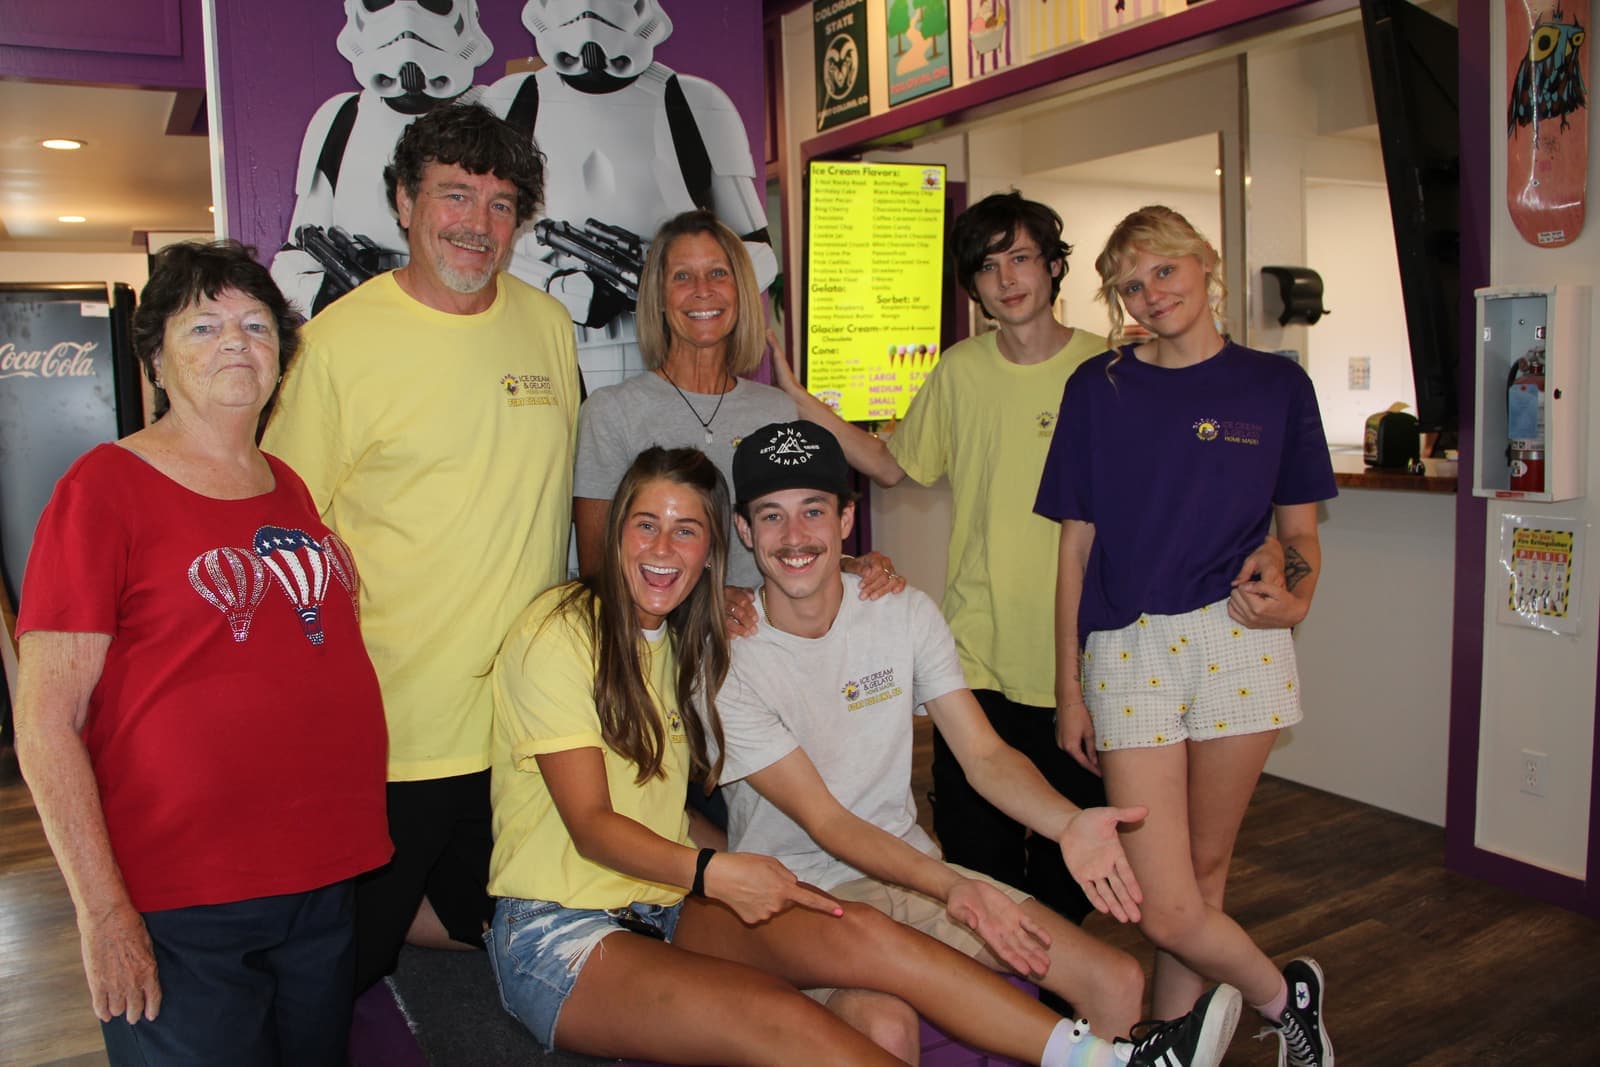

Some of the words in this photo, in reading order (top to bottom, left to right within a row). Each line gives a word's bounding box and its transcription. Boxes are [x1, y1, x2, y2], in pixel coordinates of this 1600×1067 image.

[815, 0, 862, 22] COLORAD
[825, 12, 854, 35] STATE
[812, 166, 825, 175] Ice
[827, 166, 860, 177] Cream
[862, 167, 899, 178] Flavors:
[811, 284, 846, 293] Gelato:
[876, 294, 910, 304] Sorbet:
[811, 325, 844, 334] Glacier
[811, 345, 839, 355] Cone:
[868, 373, 896, 382] LARGE
[868, 384, 903, 394] MEDIUM
[868, 397, 896, 406] SMALL
[769, 452, 814, 466] CANADA
[860, 675, 870, 685] ICE
[870, 667, 894, 681] CREAM
[869, 674, 893, 688] GELATO
